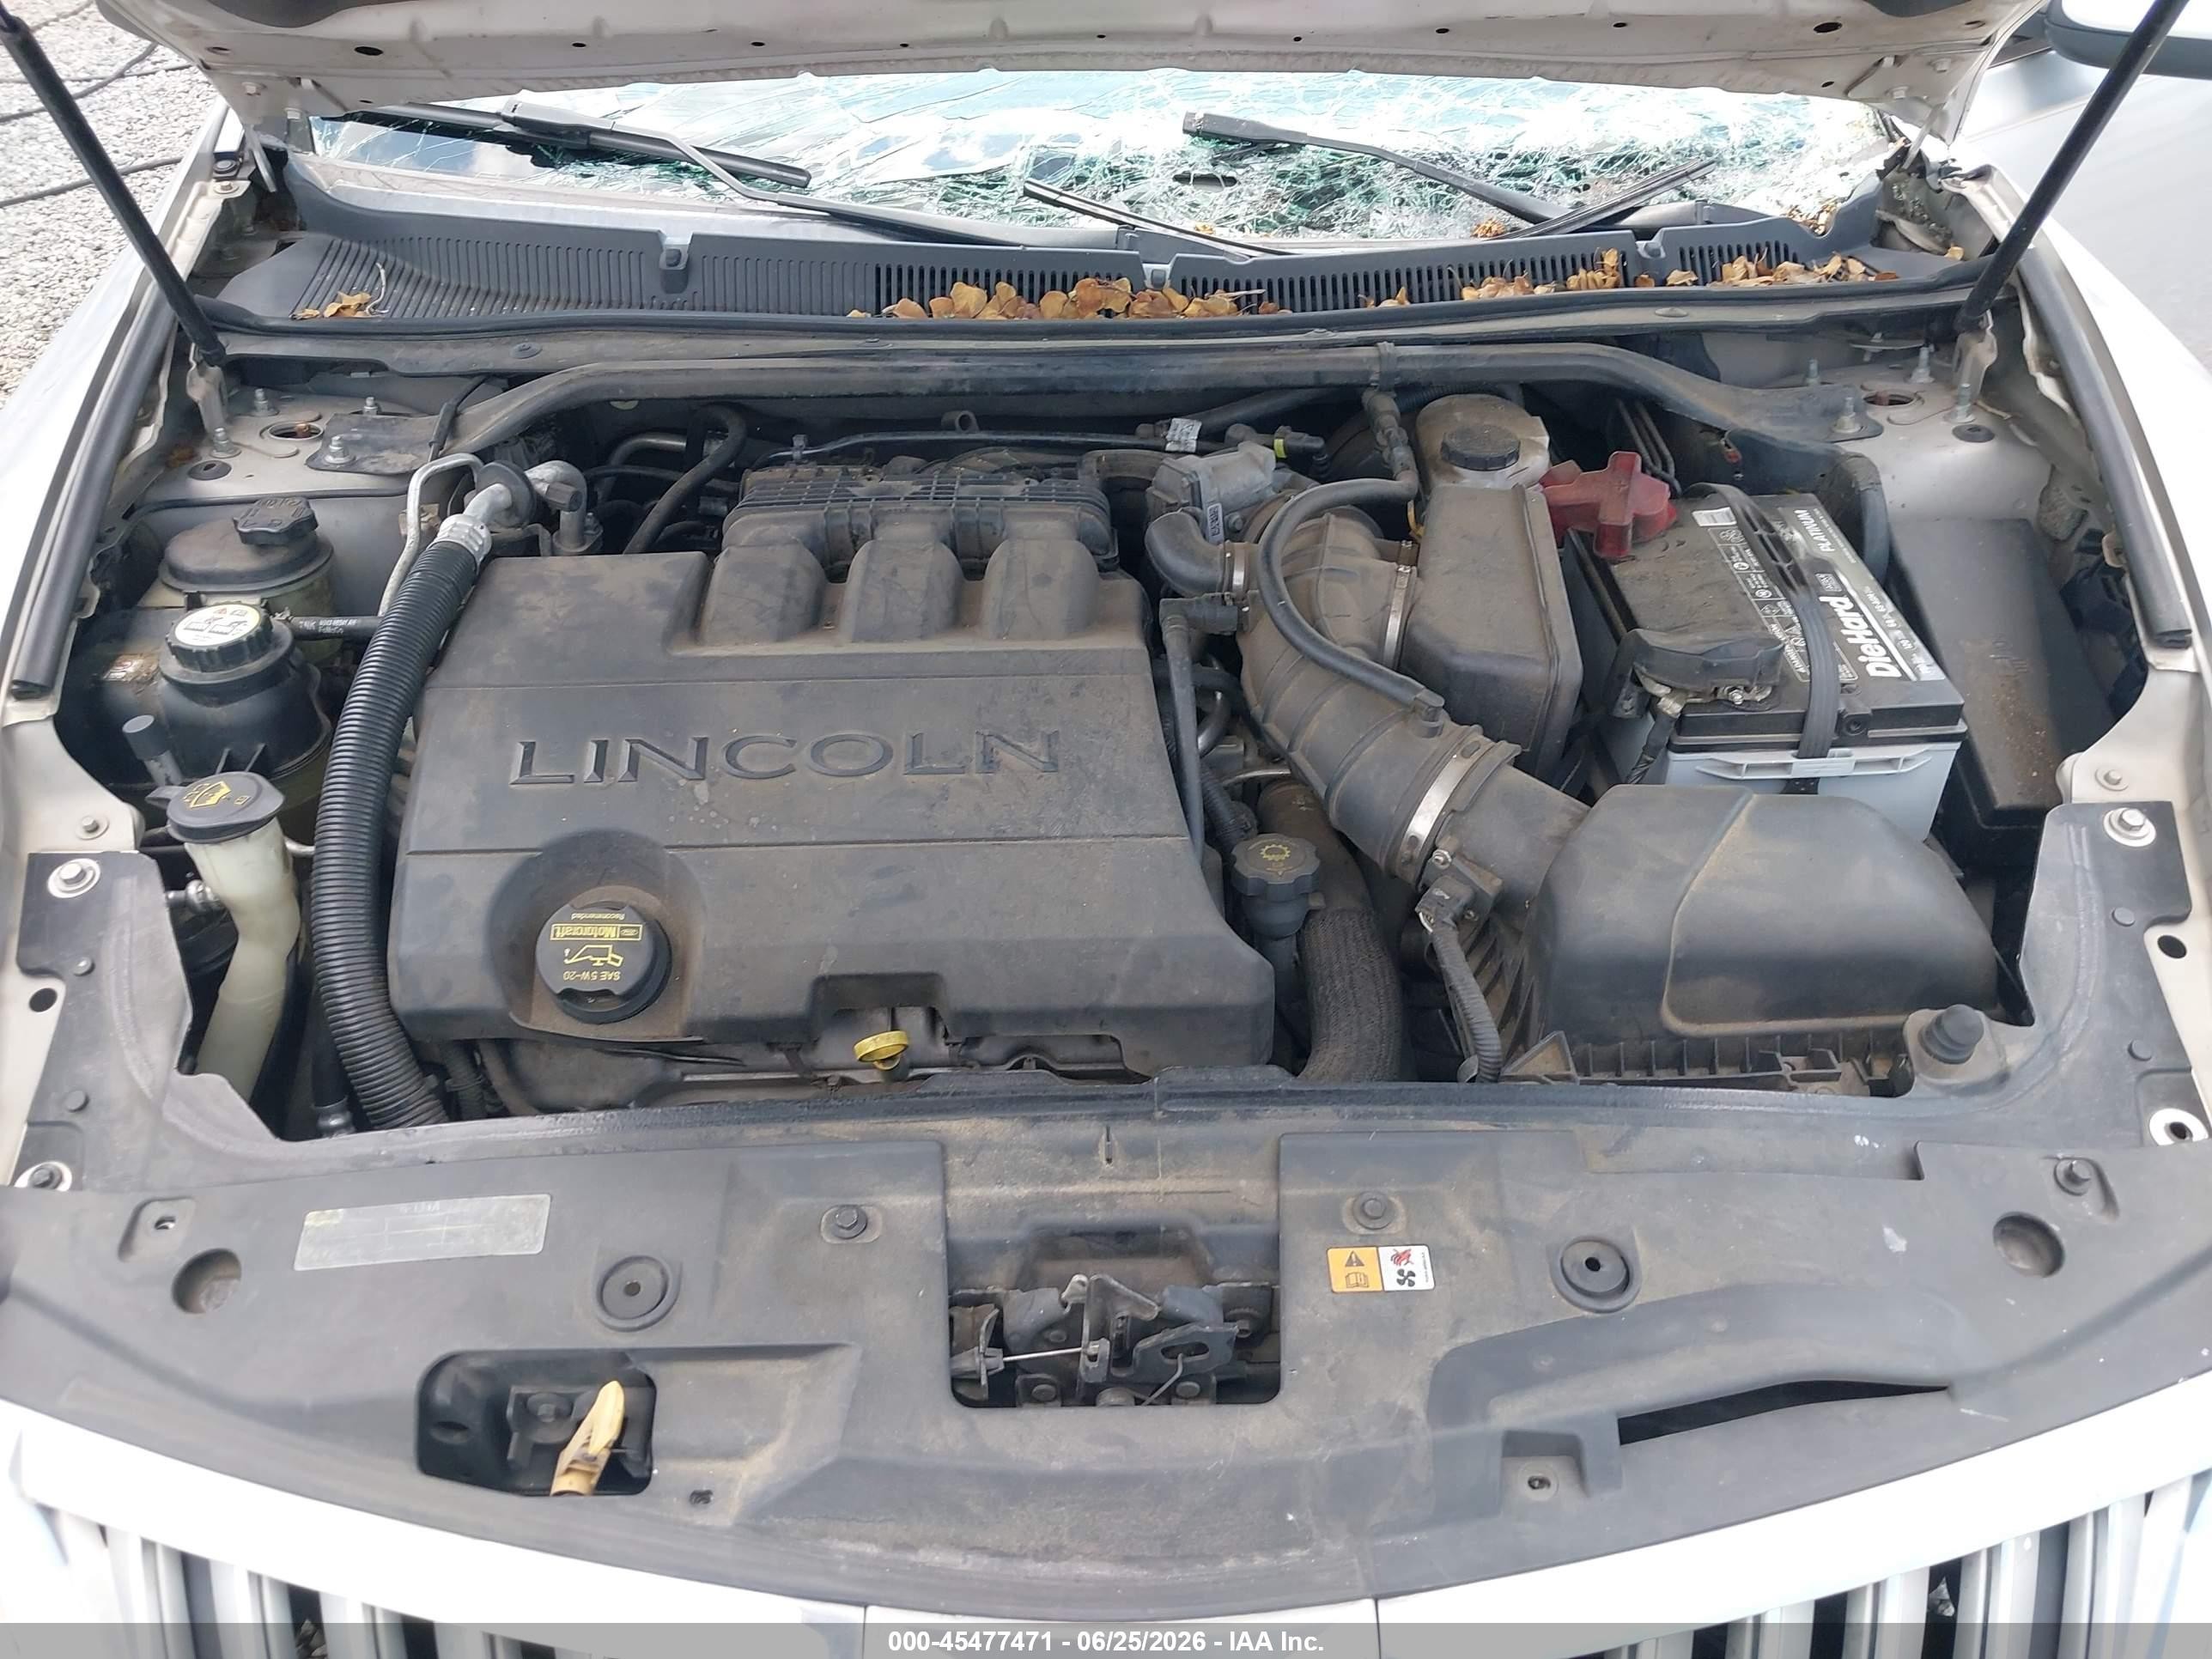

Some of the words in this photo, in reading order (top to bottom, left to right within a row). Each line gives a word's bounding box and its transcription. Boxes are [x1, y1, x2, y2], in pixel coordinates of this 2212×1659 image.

[1794, 509, 1835, 552] PLATINUM
[1818, 596, 1902, 678] DieHard
[508, 730, 1059, 785] LINCOLN
[555, 927, 617, 938] Motorcraft
[562, 971, 598, 981] 5W-20
[599, 971, 622, 981] SAE
